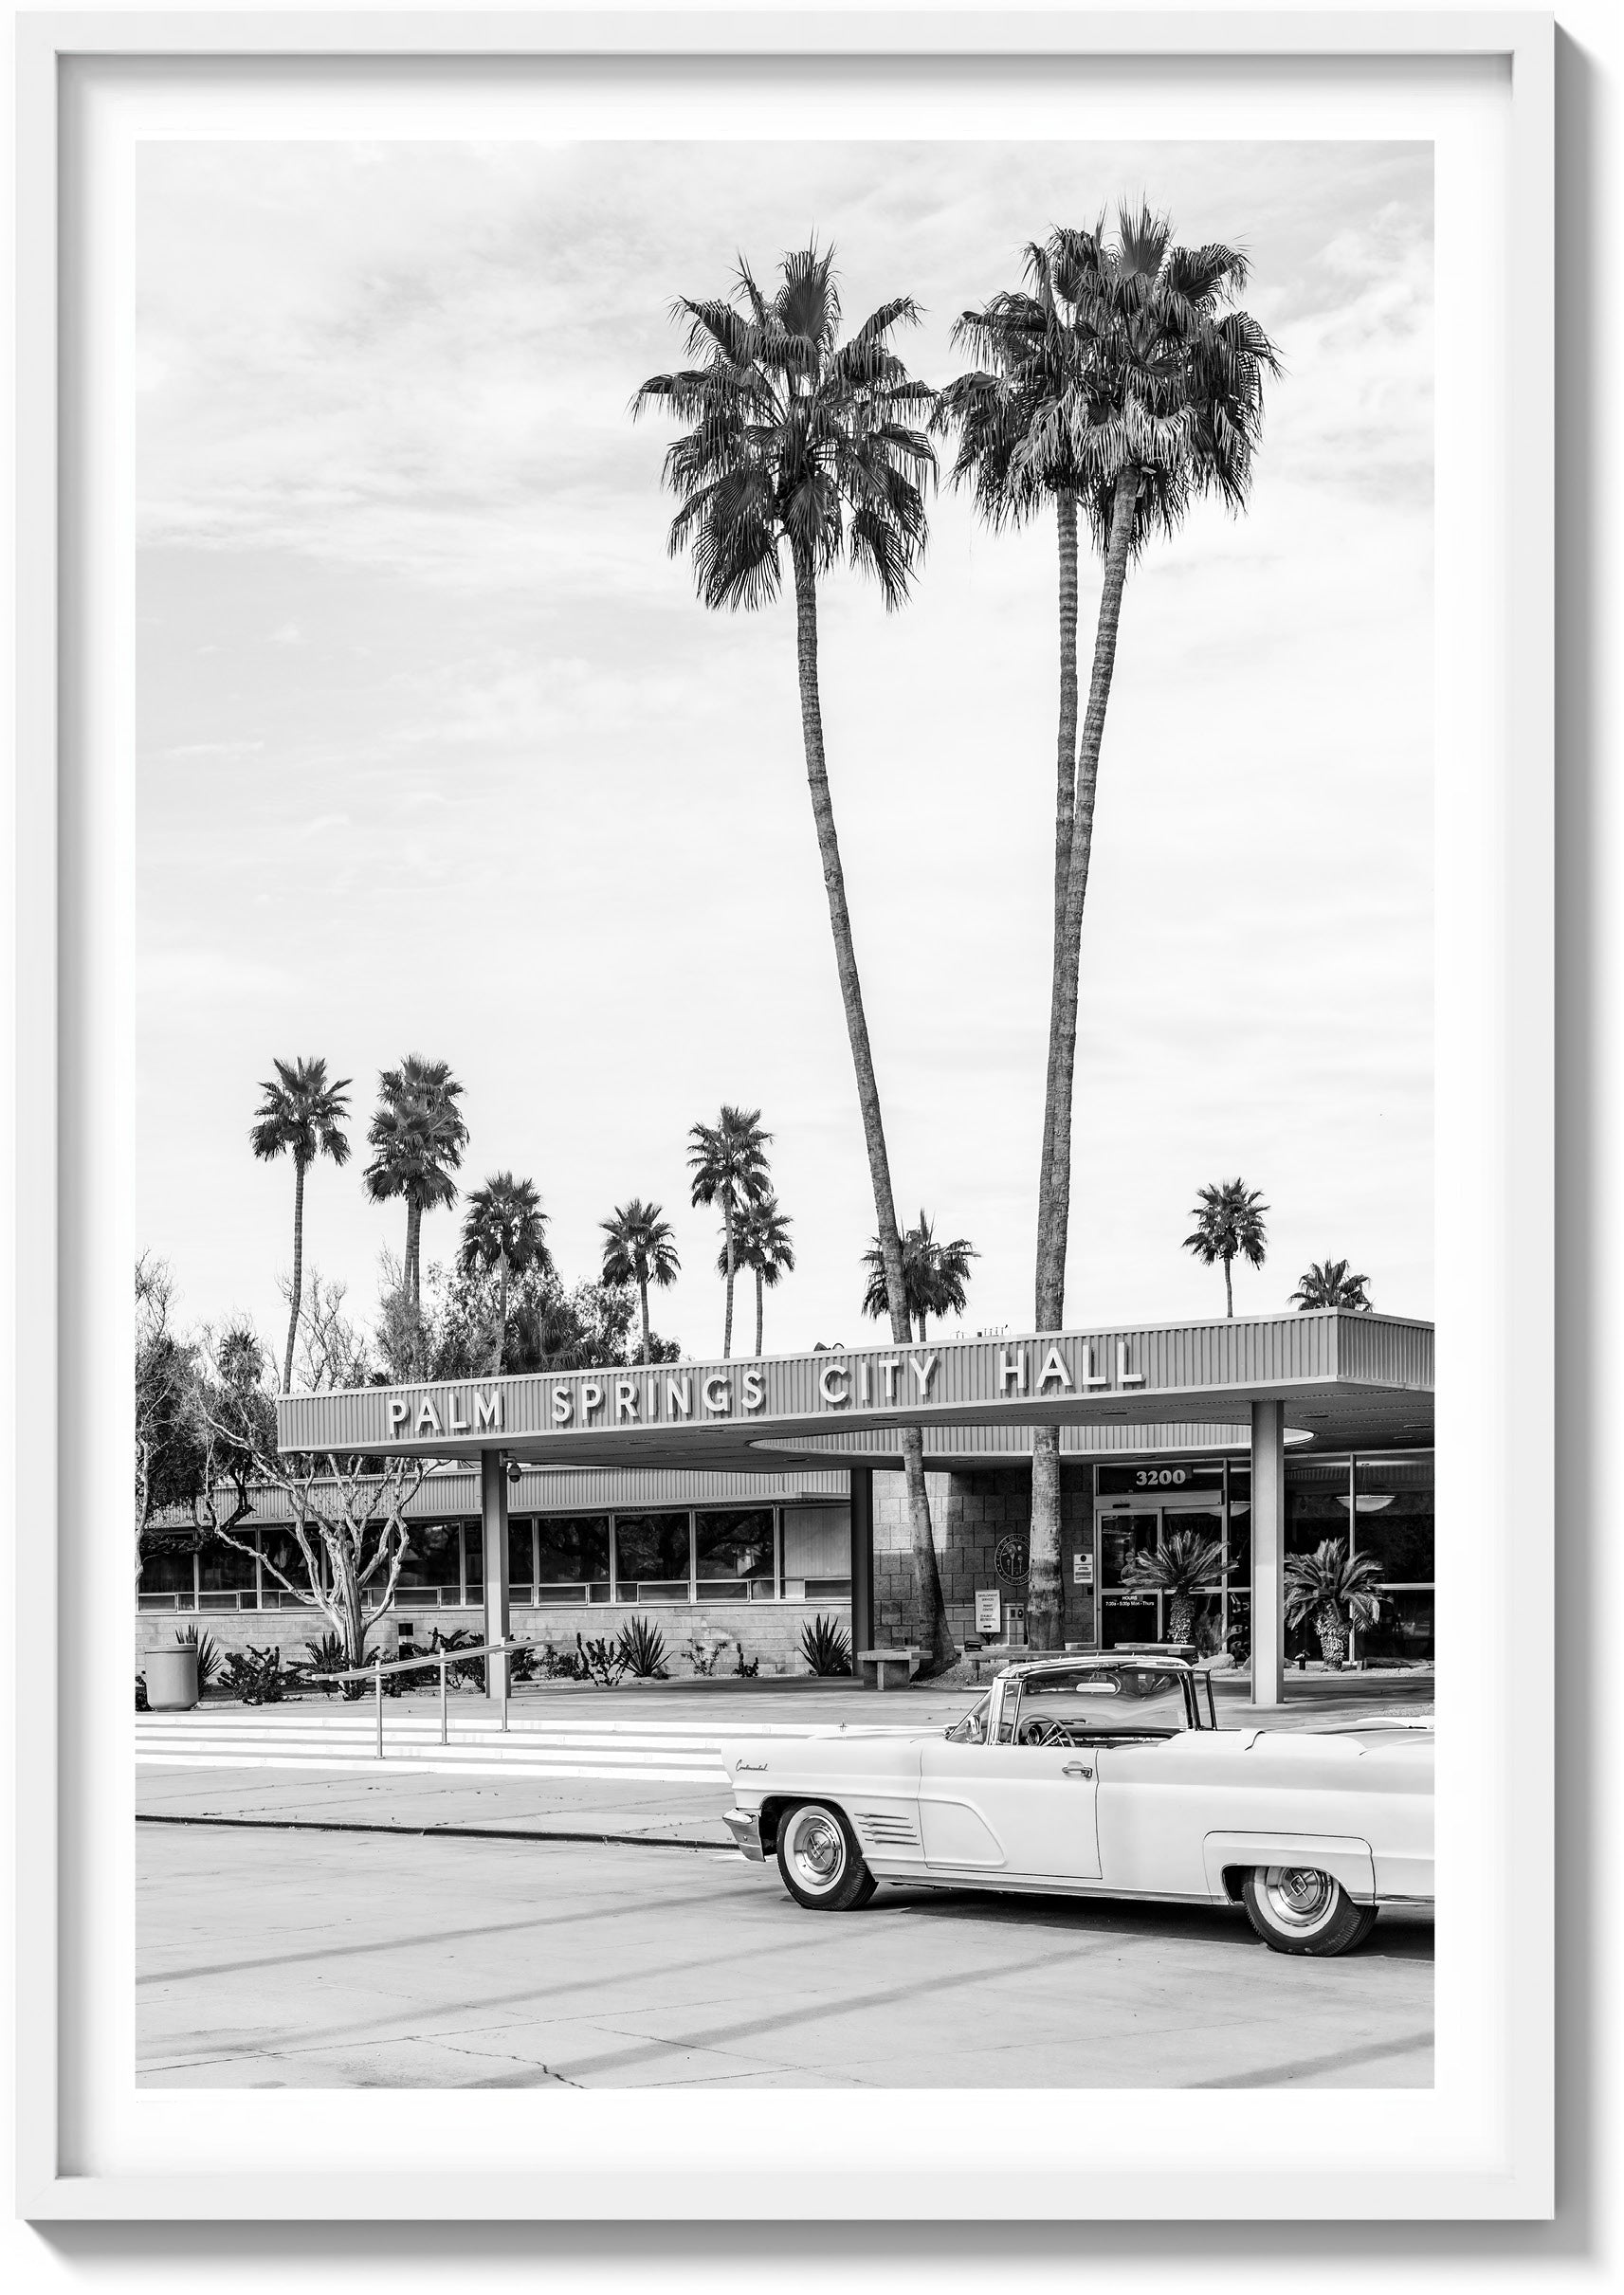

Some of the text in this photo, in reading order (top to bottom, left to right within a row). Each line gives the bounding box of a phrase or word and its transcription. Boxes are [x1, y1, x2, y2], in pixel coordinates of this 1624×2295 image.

[389, 1341, 1144, 1434] PALM SPRINGS CITY HALL
[1136, 1469, 1186, 1485] 3200
[736, 1758, 769, 1772] Continental
